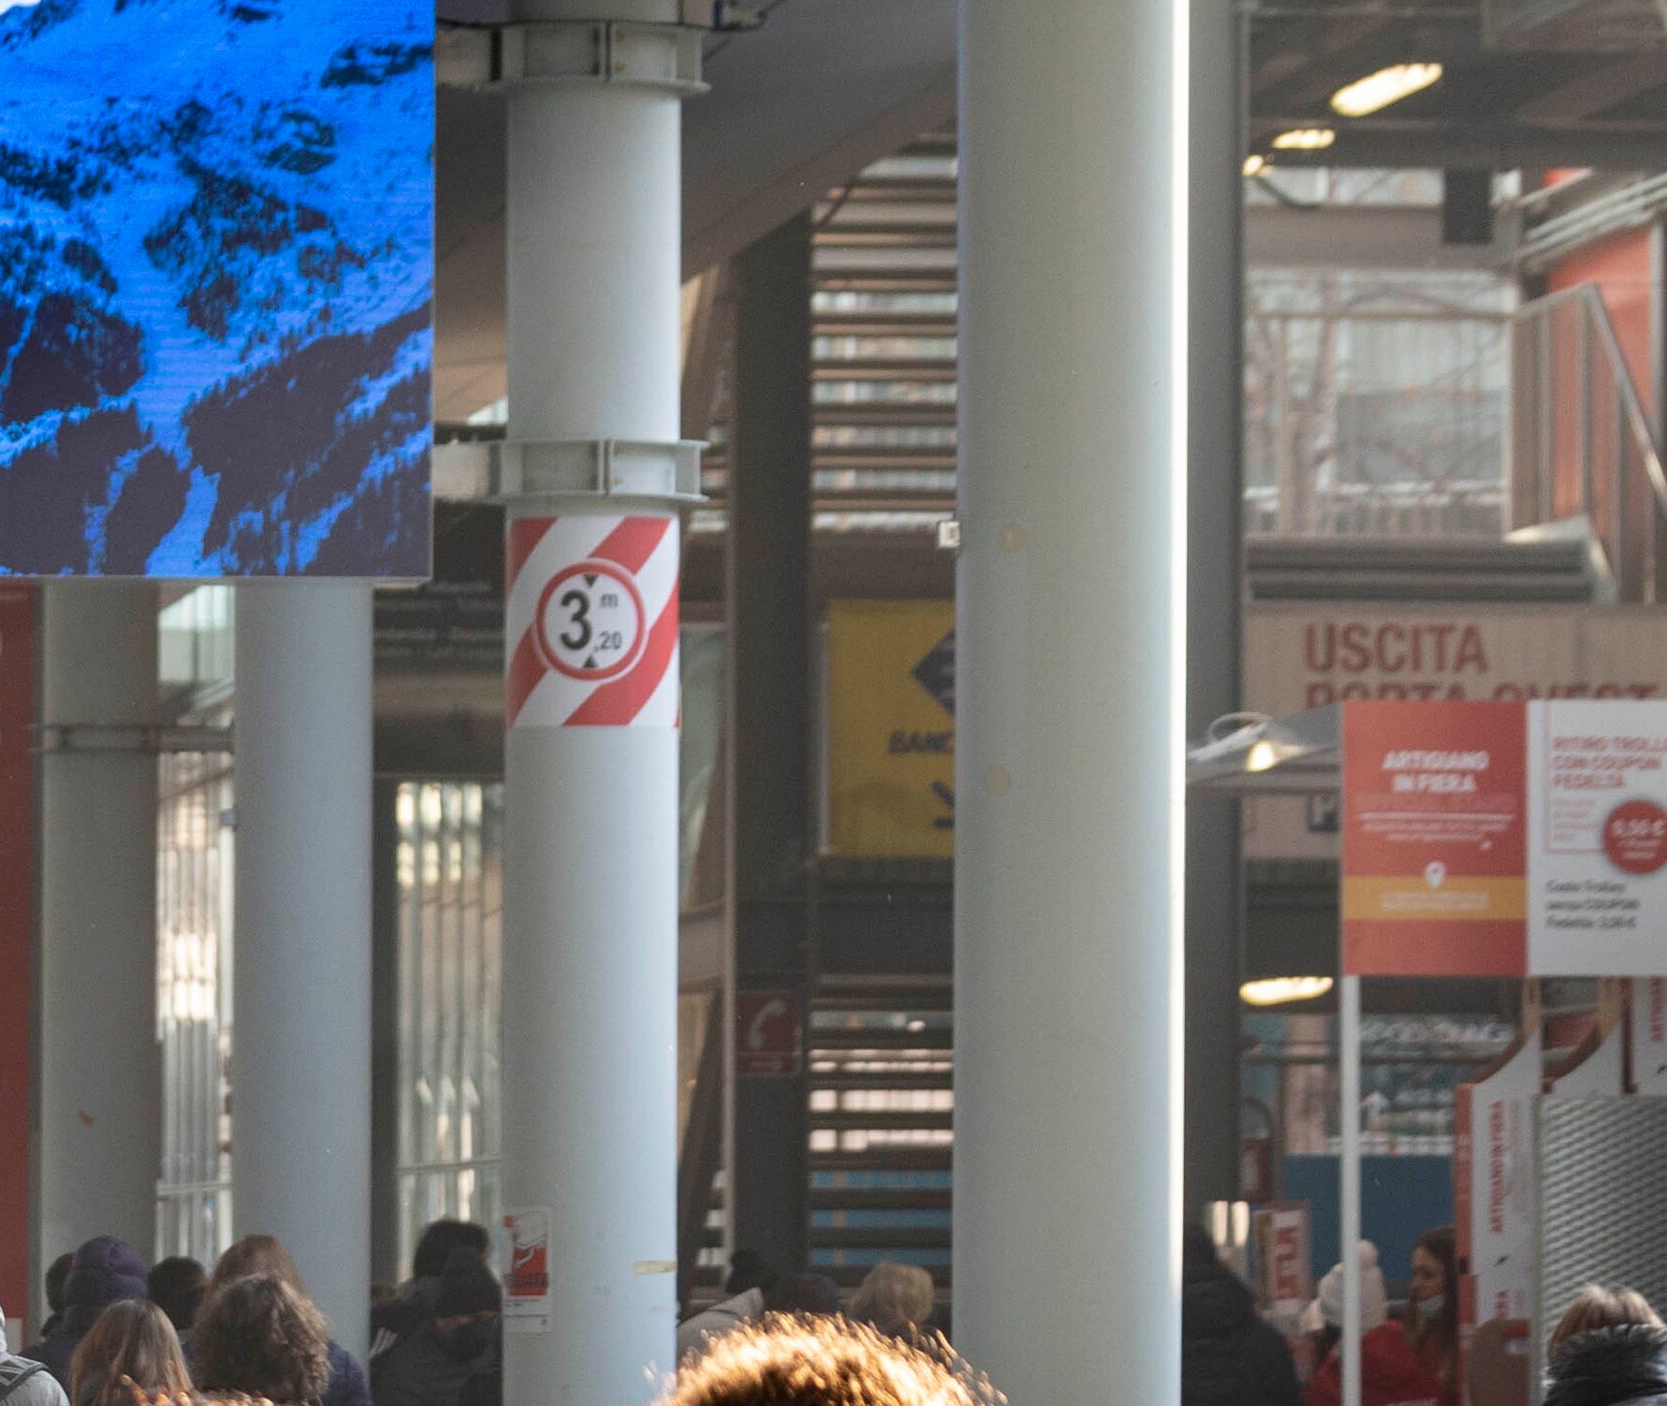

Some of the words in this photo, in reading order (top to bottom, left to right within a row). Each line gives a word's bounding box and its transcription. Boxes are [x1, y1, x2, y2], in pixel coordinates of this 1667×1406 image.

[560, 590, 592, 650] 3
[600, 593, 618, 608] m
[1305, 622, 1489, 674] USCITA
[1382, 750, 1490, 771] ARTIGIANO
[1417, 773, 1477, 793] FIERA
